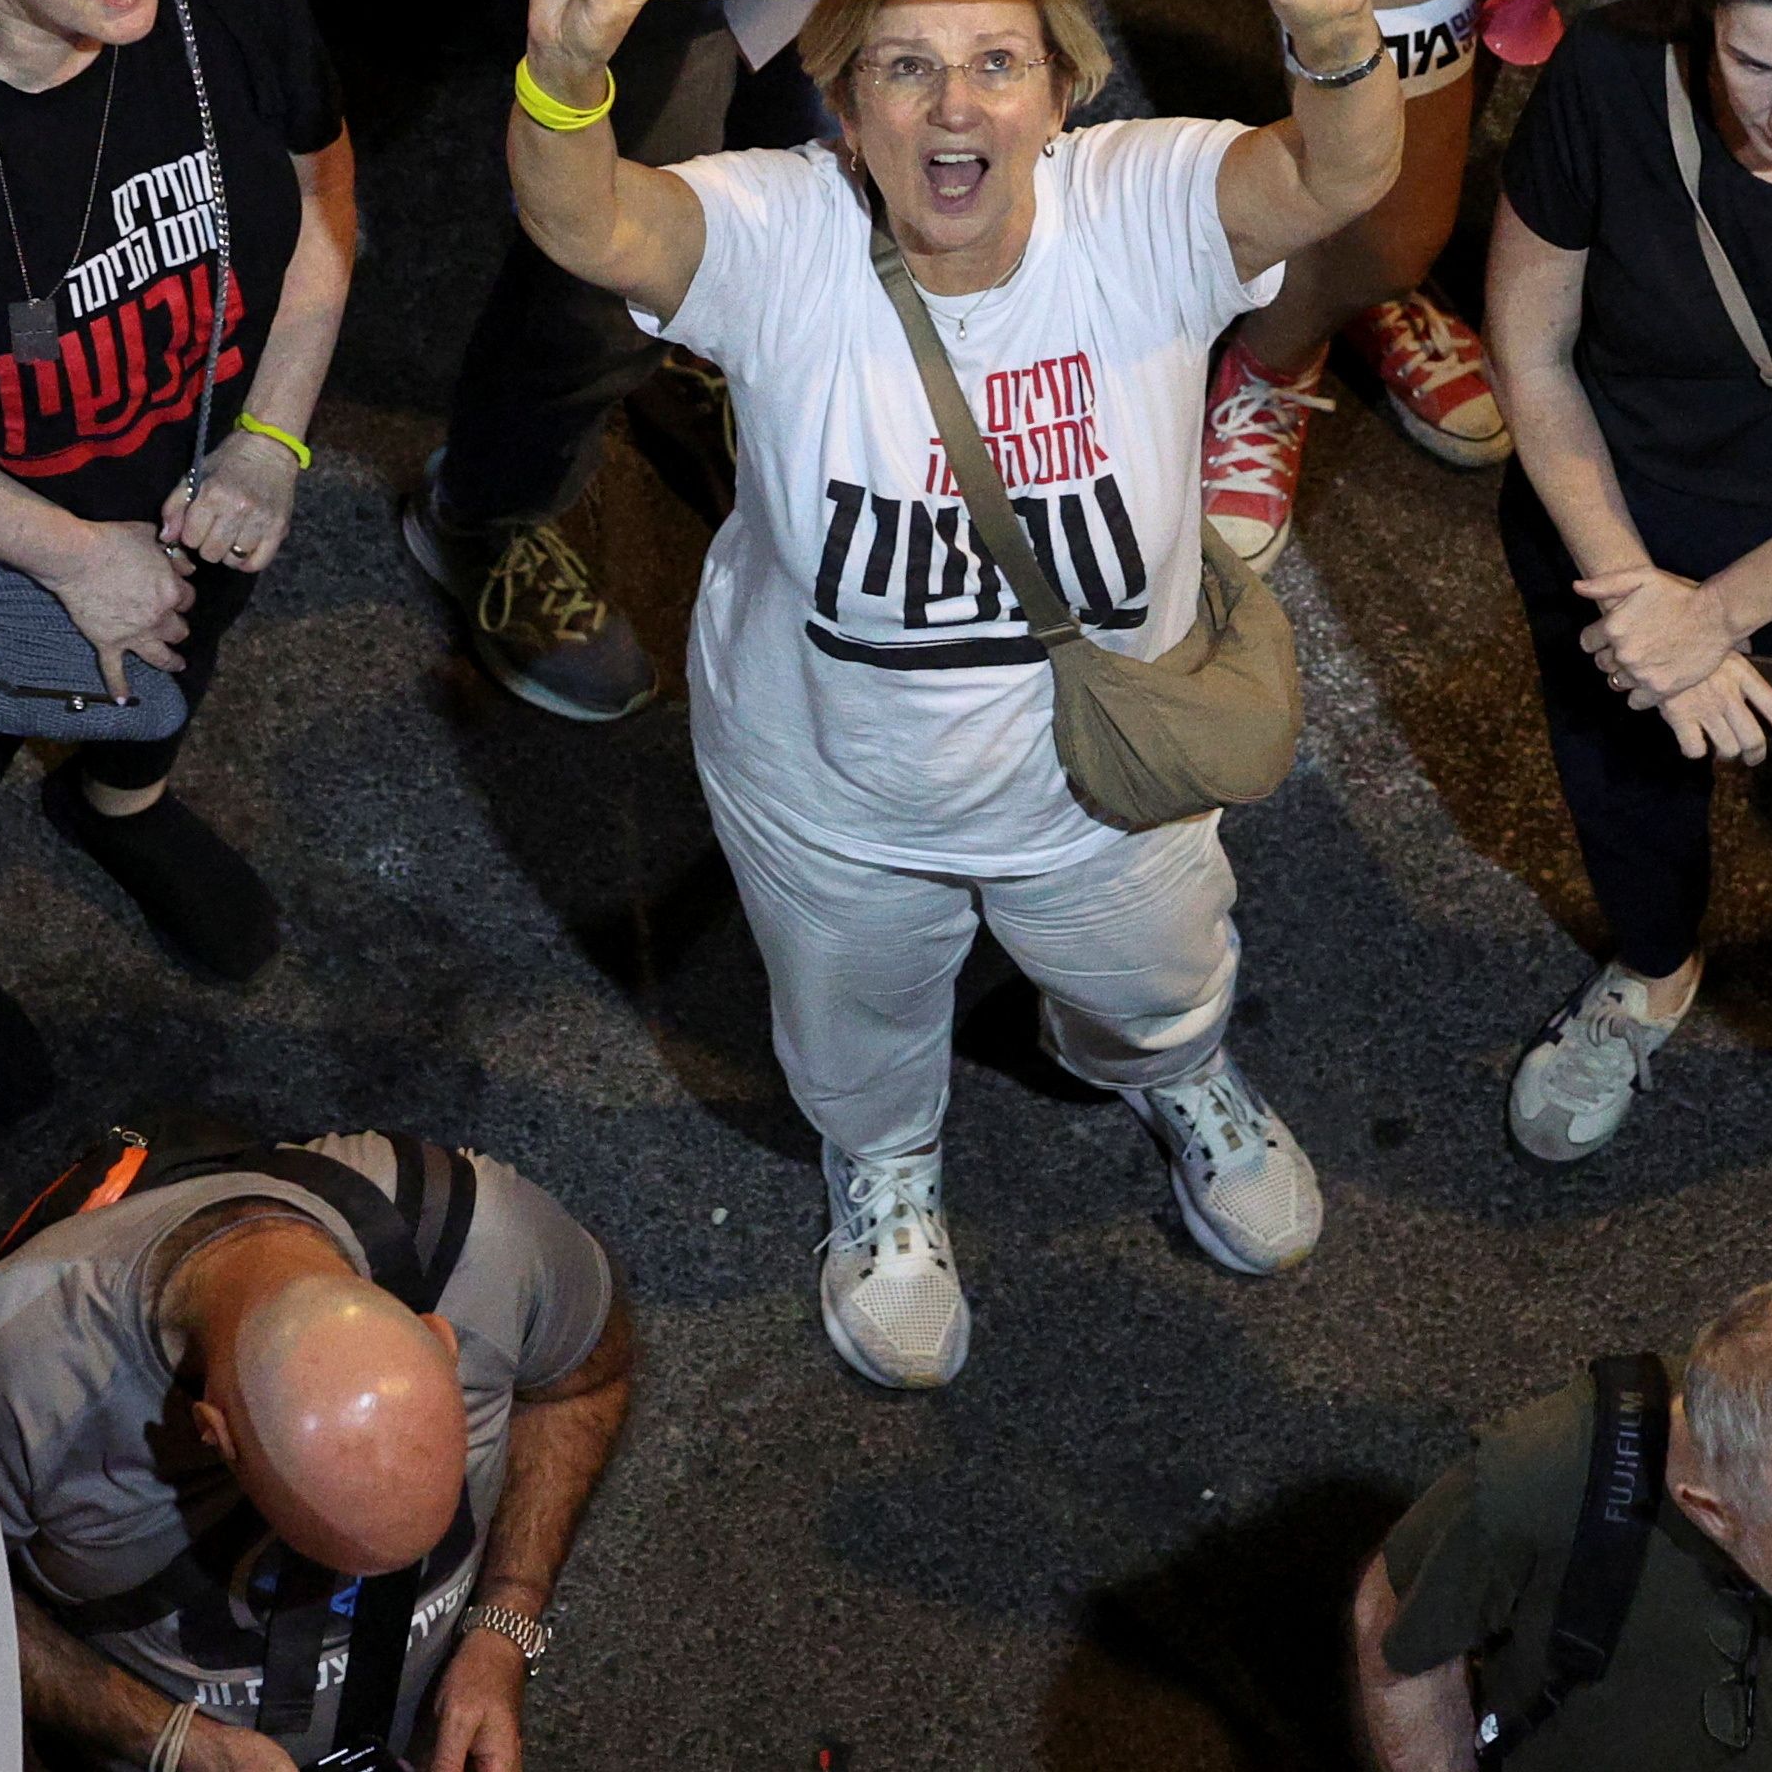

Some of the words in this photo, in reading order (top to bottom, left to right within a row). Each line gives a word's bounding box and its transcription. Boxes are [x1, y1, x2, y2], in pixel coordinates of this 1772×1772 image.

[64, 226, 158, 318] הביתה
[155, 201, 219, 268] ותם
[1604, 1391, 1645, 1523] FUJIFILM
